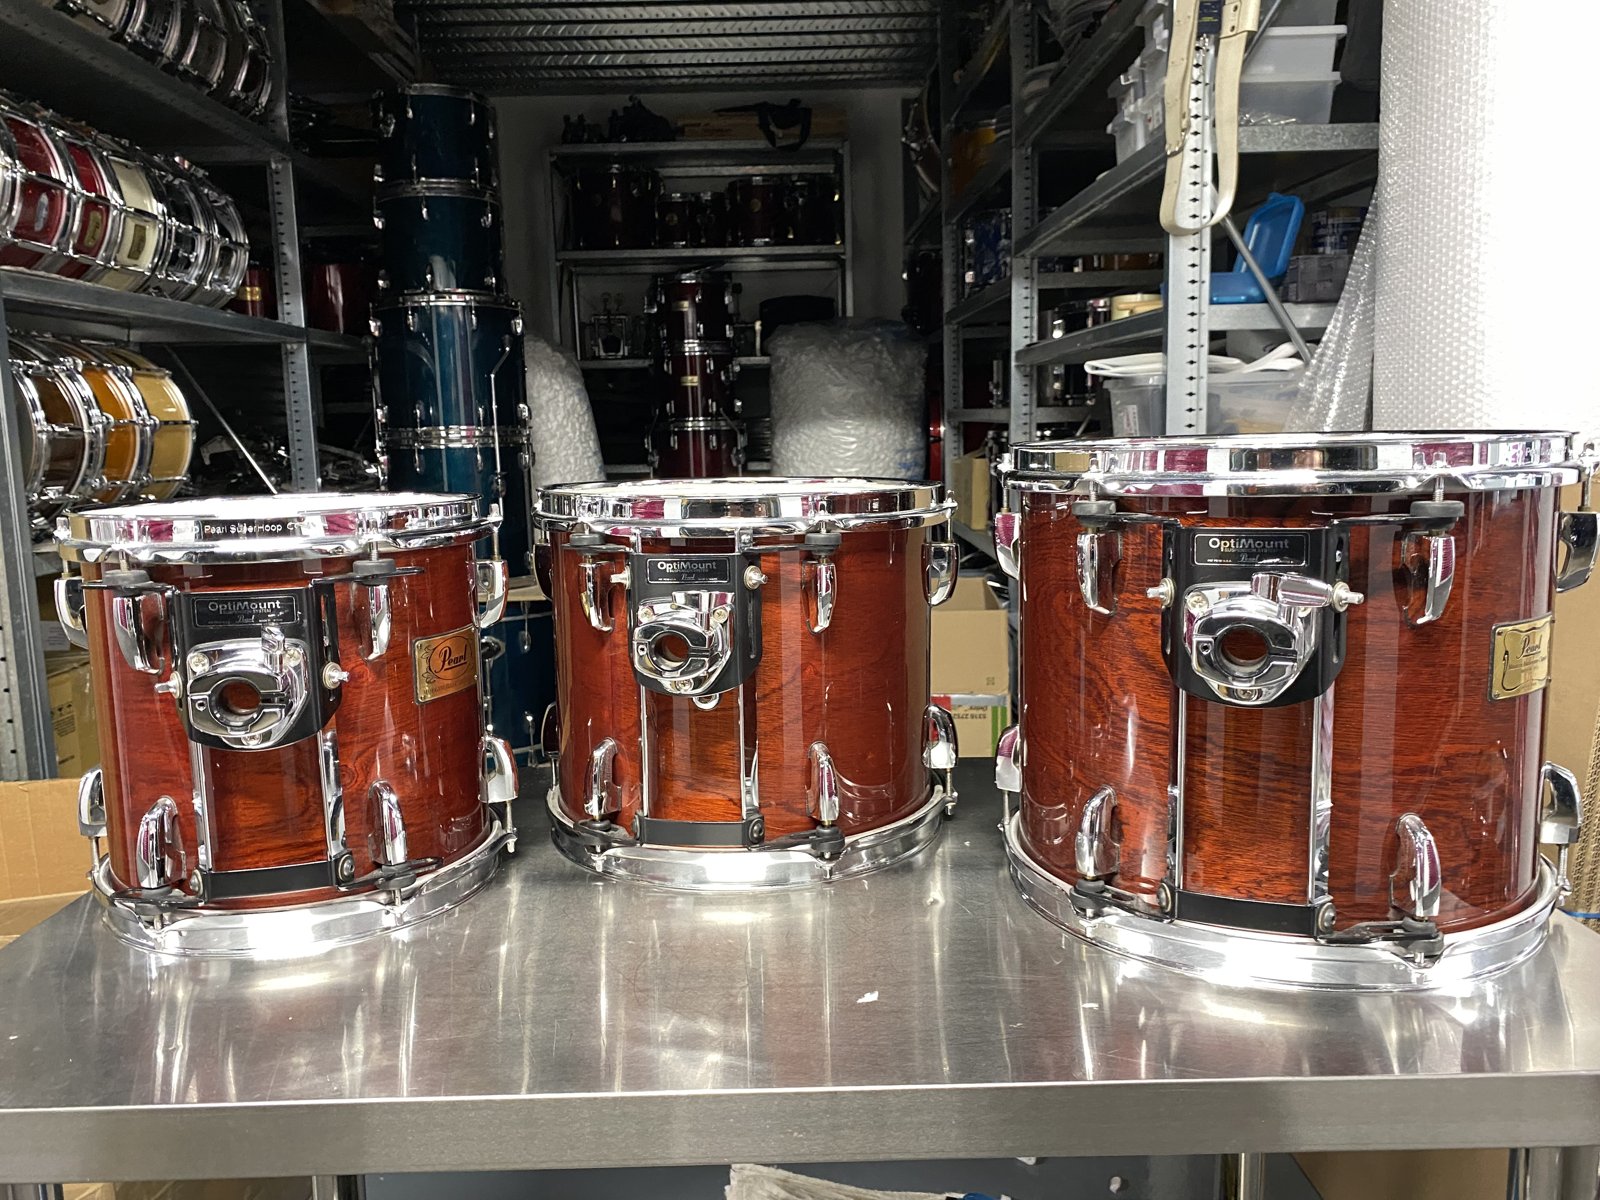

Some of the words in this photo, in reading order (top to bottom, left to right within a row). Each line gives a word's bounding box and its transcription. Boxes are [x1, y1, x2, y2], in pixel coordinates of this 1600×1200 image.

[204, 524, 227, 534] Pearl
[1208, 537, 1289, 552] OptiMount
[657, 561, 717, 573] OptiMount
[208, 599, 281, 614] OptiMount
[1516, 634, 1543, 659] Pearl
[434, 644, 468, 673] Pearl
